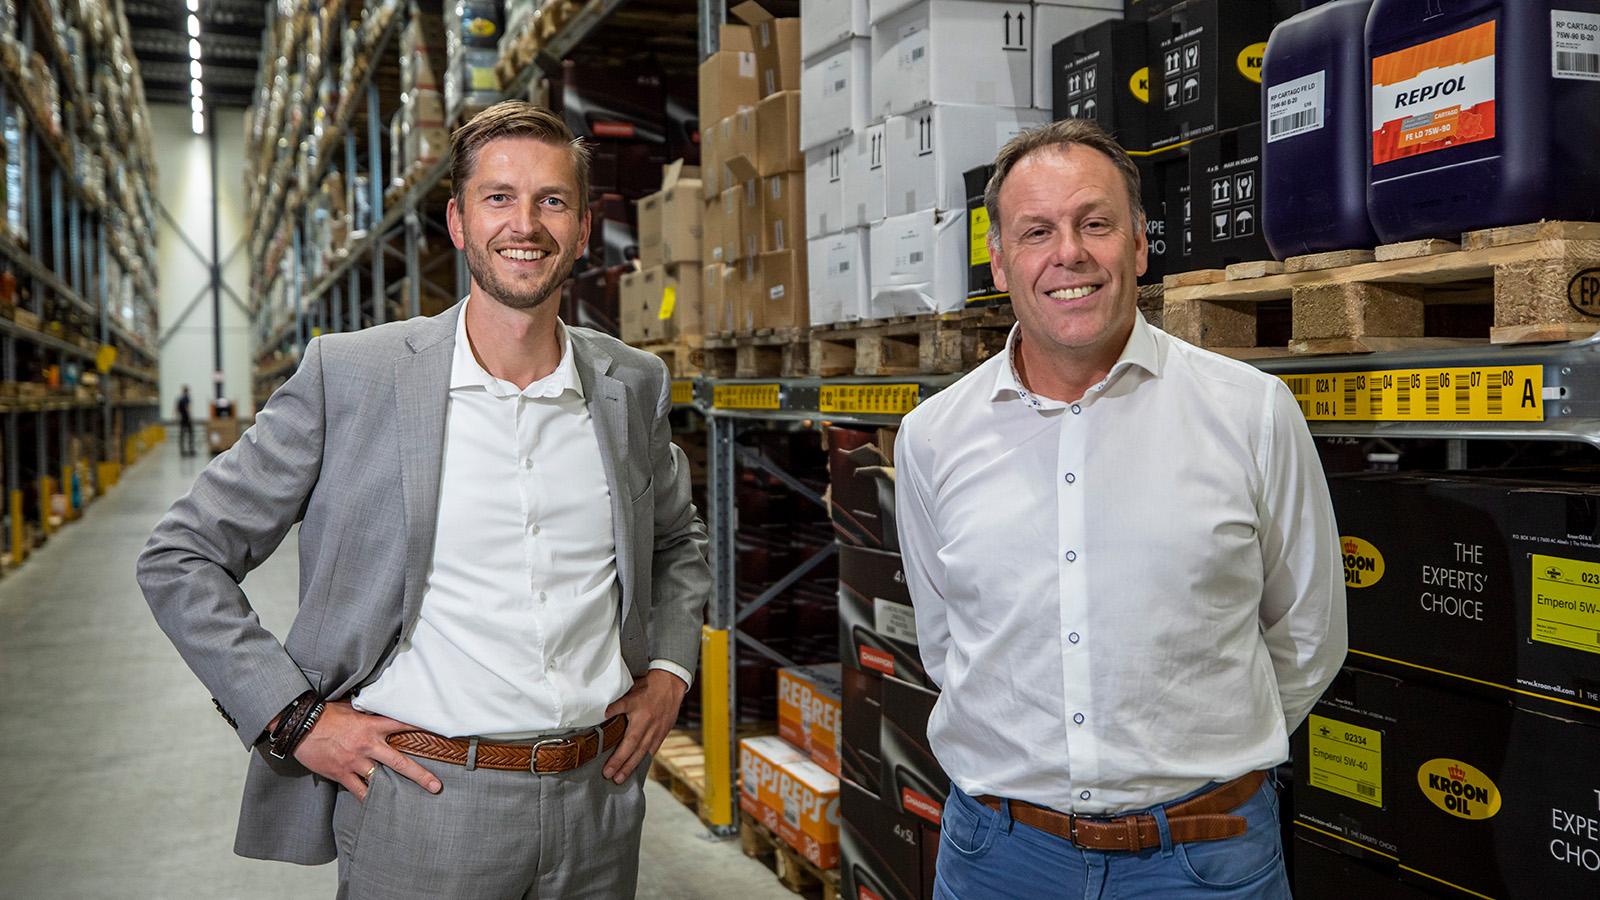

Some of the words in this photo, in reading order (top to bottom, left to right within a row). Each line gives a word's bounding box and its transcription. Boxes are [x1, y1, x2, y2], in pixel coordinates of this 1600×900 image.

[1566, 22, 1598, 32] CARTAGO
[1278, 87, 1301, 99] CARTAGO
[1394, 76, 1466, 109] REPSOL
[1405, 133, 1414, 142] FE
[1414, 130, 1424, 139] LD
[1424, 123, 1452, 137] 75W-90
[1315, 378, 1330, 393] 02A
[1356, 375, 1366, 390] 03
[1383, 374, 1393, 390] 04
[1410, 373, 1421, 389] 05
[1439, 372, 1450, 388] 06
[1470, 371, 1481, 387] 07
[1502, 370, 1514, 387] 08
[1521, 377, 1537, 409] A
[1315, 401, 1330, 416] 01A
[1453, 542, 1484, 565] THE
[1344, 569, 1362, 584] OIL
[1422, 565, 1488, 593] EXPERTS'
[1420, 591, 1484, 622] CHOICE
[1537, 594, 1577, 612] Emperol
[1586, 691, 1599, 701] THE
[1344, 731, 1368, 746] 02334
[1312, 747, 1342, 764] Emperol
[1343, 756, 1368, 772] 5W-40
[1428, 772, 1489, 805] KROON
[1444, 793, 1472, 816] OIL
[1551, 807, 1599, 842] EXPE
[1550, 838, 1600, 872] CHO
